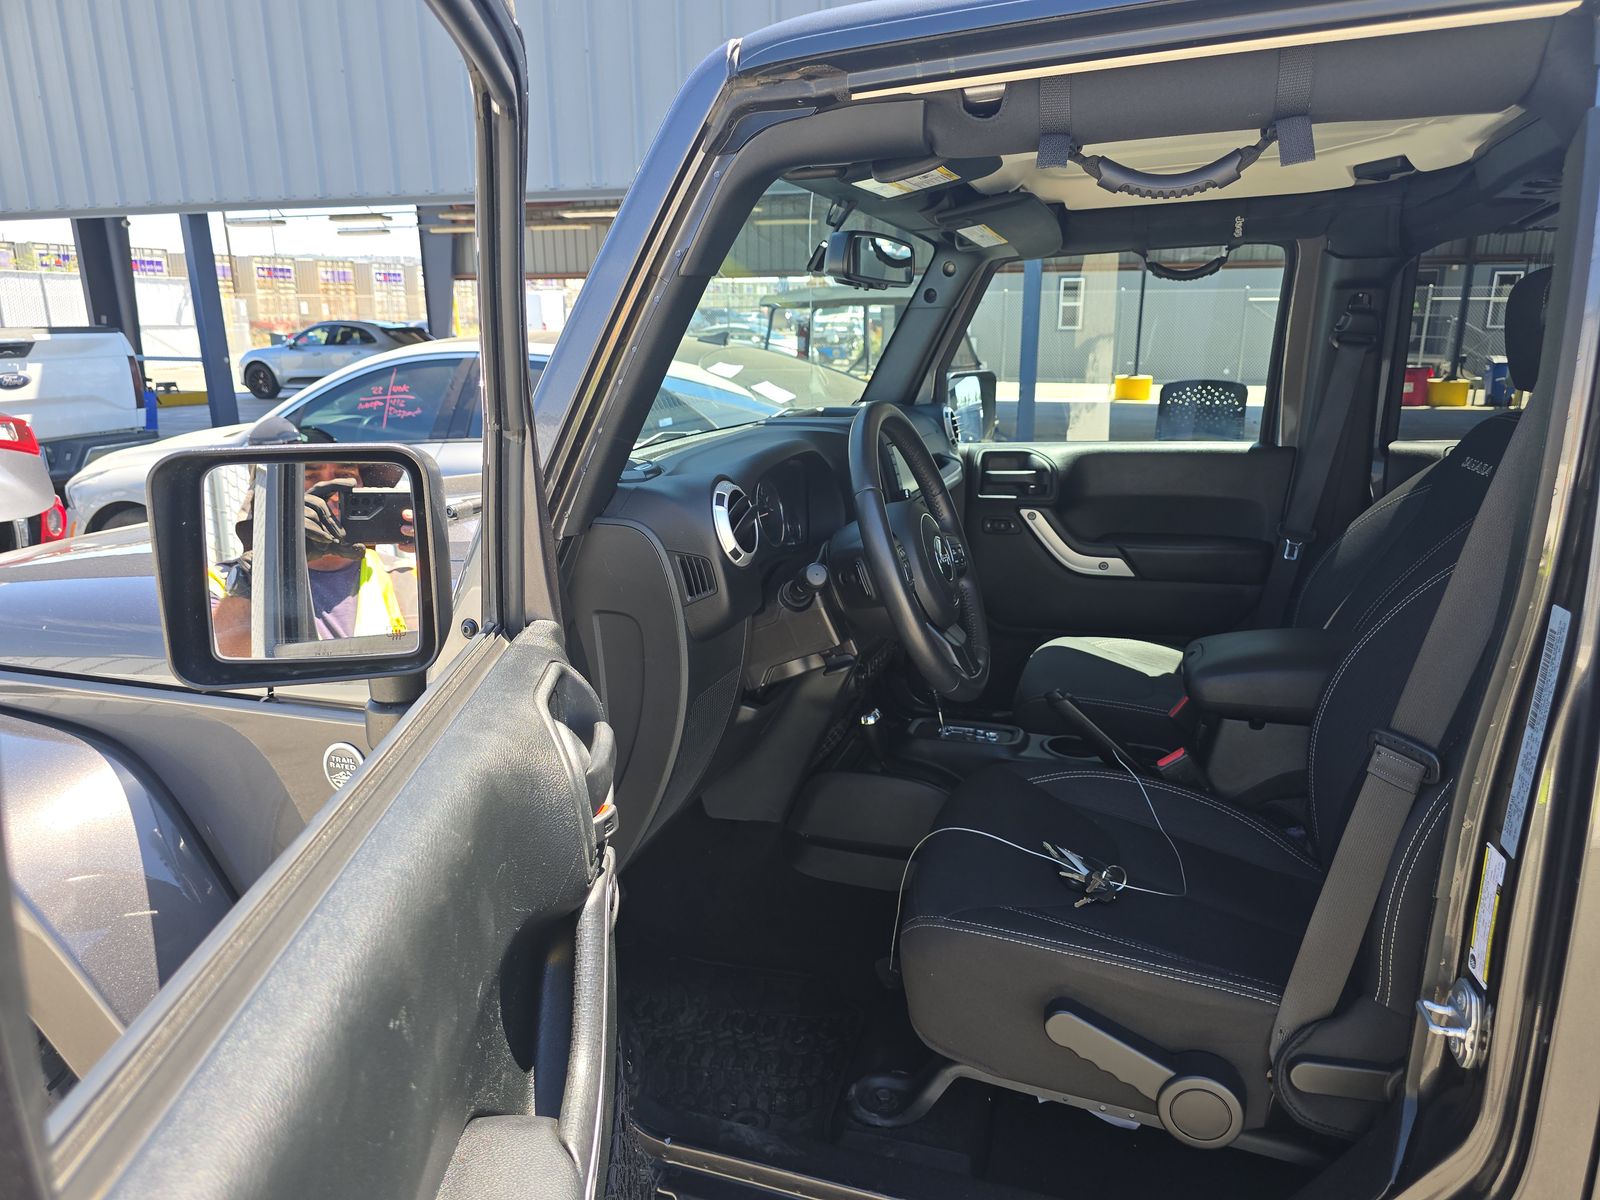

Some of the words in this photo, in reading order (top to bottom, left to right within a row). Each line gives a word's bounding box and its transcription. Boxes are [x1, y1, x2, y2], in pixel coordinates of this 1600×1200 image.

[2, 373, 24, 386] Ford
[331, 755, 355, 765] TRAIL
[330, 761, 357, 771] RATED
